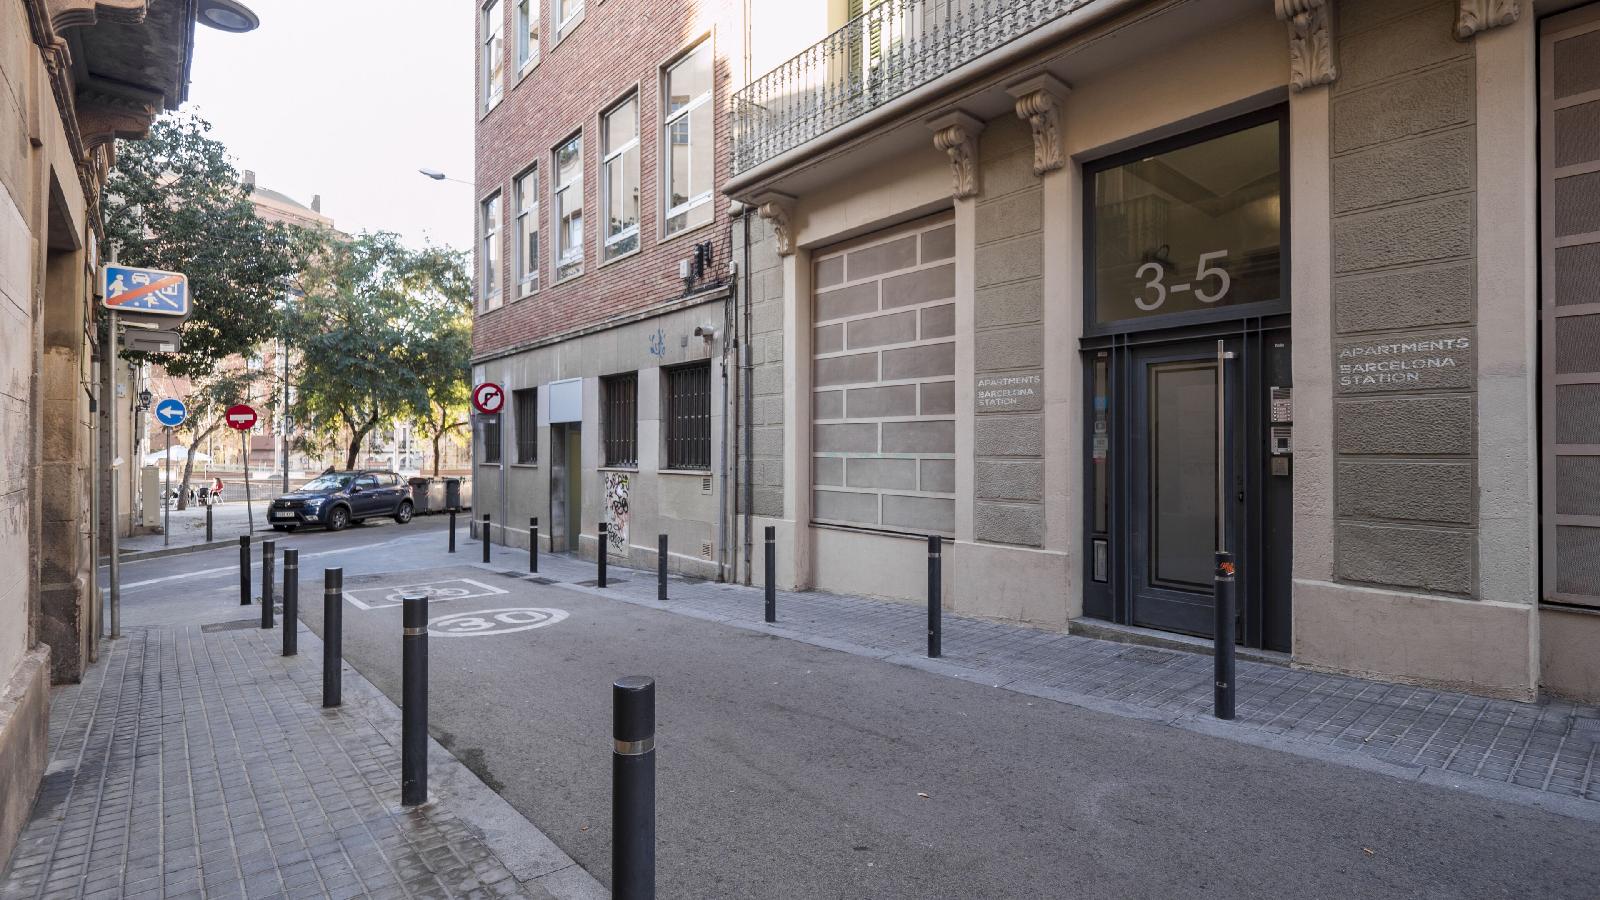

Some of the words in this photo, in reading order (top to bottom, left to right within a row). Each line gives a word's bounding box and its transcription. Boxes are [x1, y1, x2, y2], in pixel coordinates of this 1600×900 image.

[1134, 249, 1231, 311] 3-5
[1339, 338, 1470, 358] APARTMENTS
[1340, 357, 1456, 374] BARCELONA
[977, 375, 1040, 387] APARTMENTS
[1340, 372, 1419, 386] STATION
[978, 388, 1034, 398] BARCELONA
[979, 398, 1017, 407] STATION
[436, 611, 548, 632] 30
